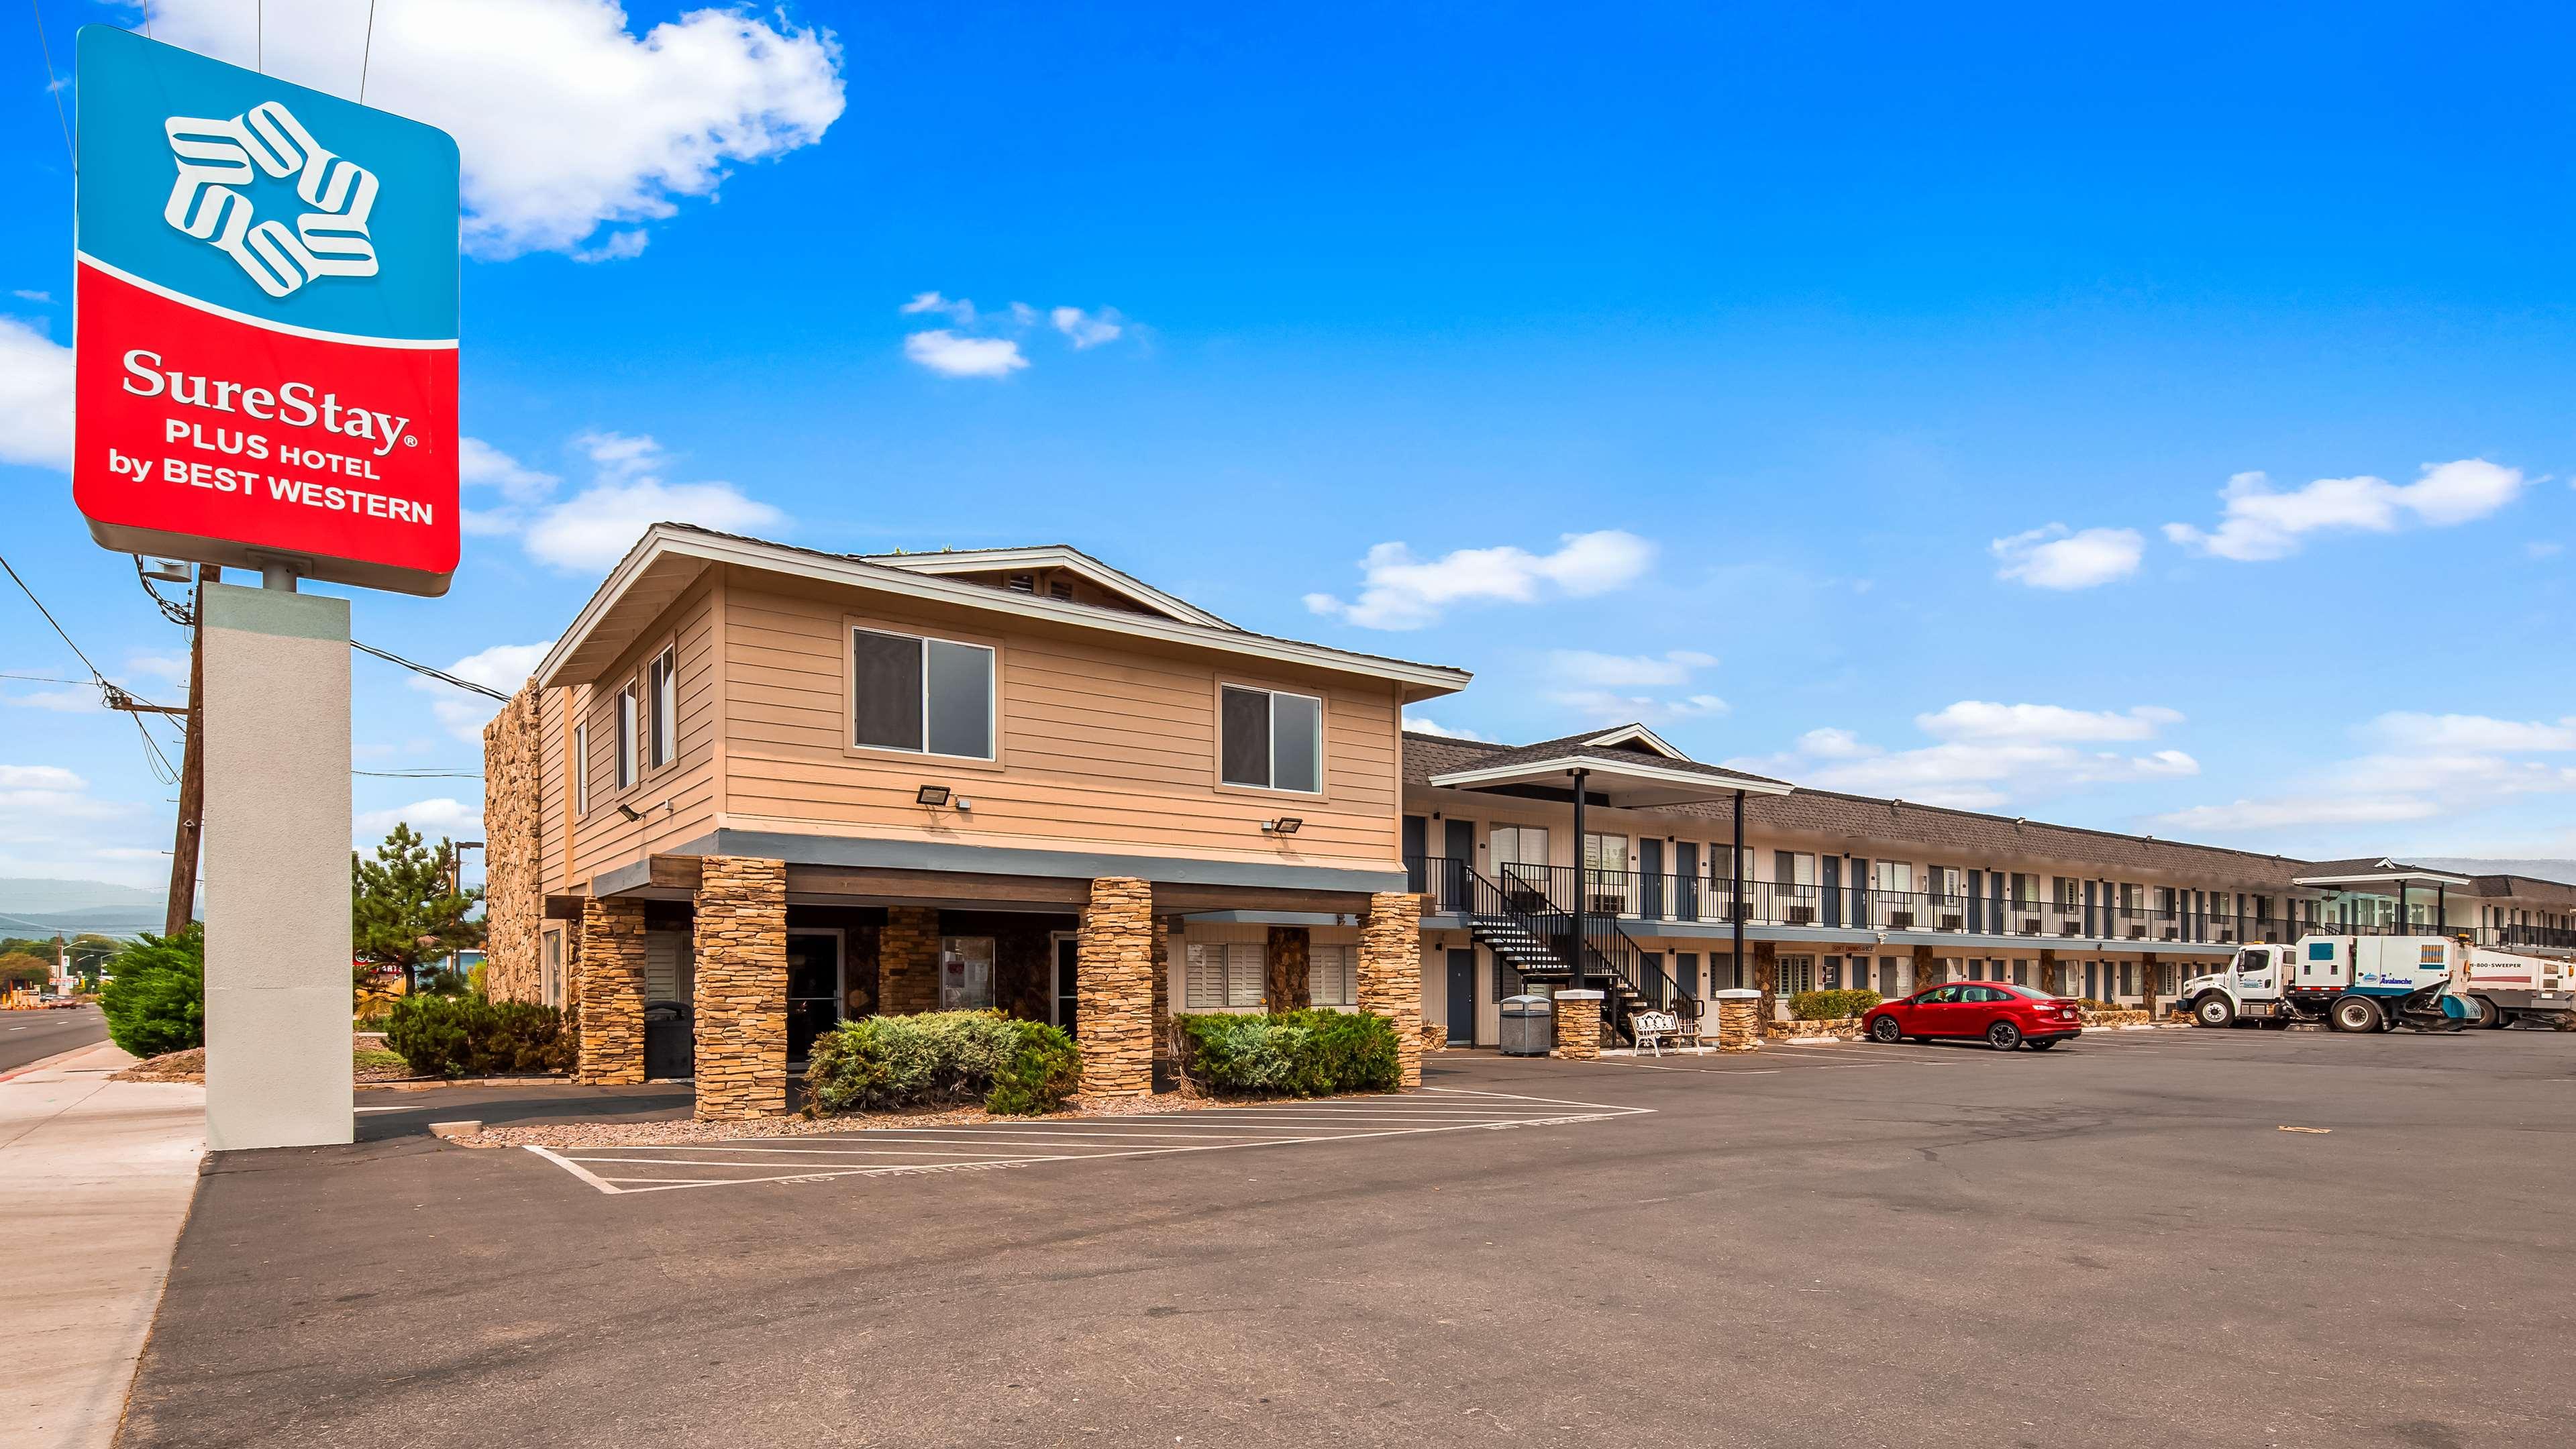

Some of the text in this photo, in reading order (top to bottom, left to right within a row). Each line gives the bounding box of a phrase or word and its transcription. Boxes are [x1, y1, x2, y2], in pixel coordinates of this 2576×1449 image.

[166, 419, 380, 480] PLUS HOTEL
[110, 449, 432, 525] by BEST WESTERN
